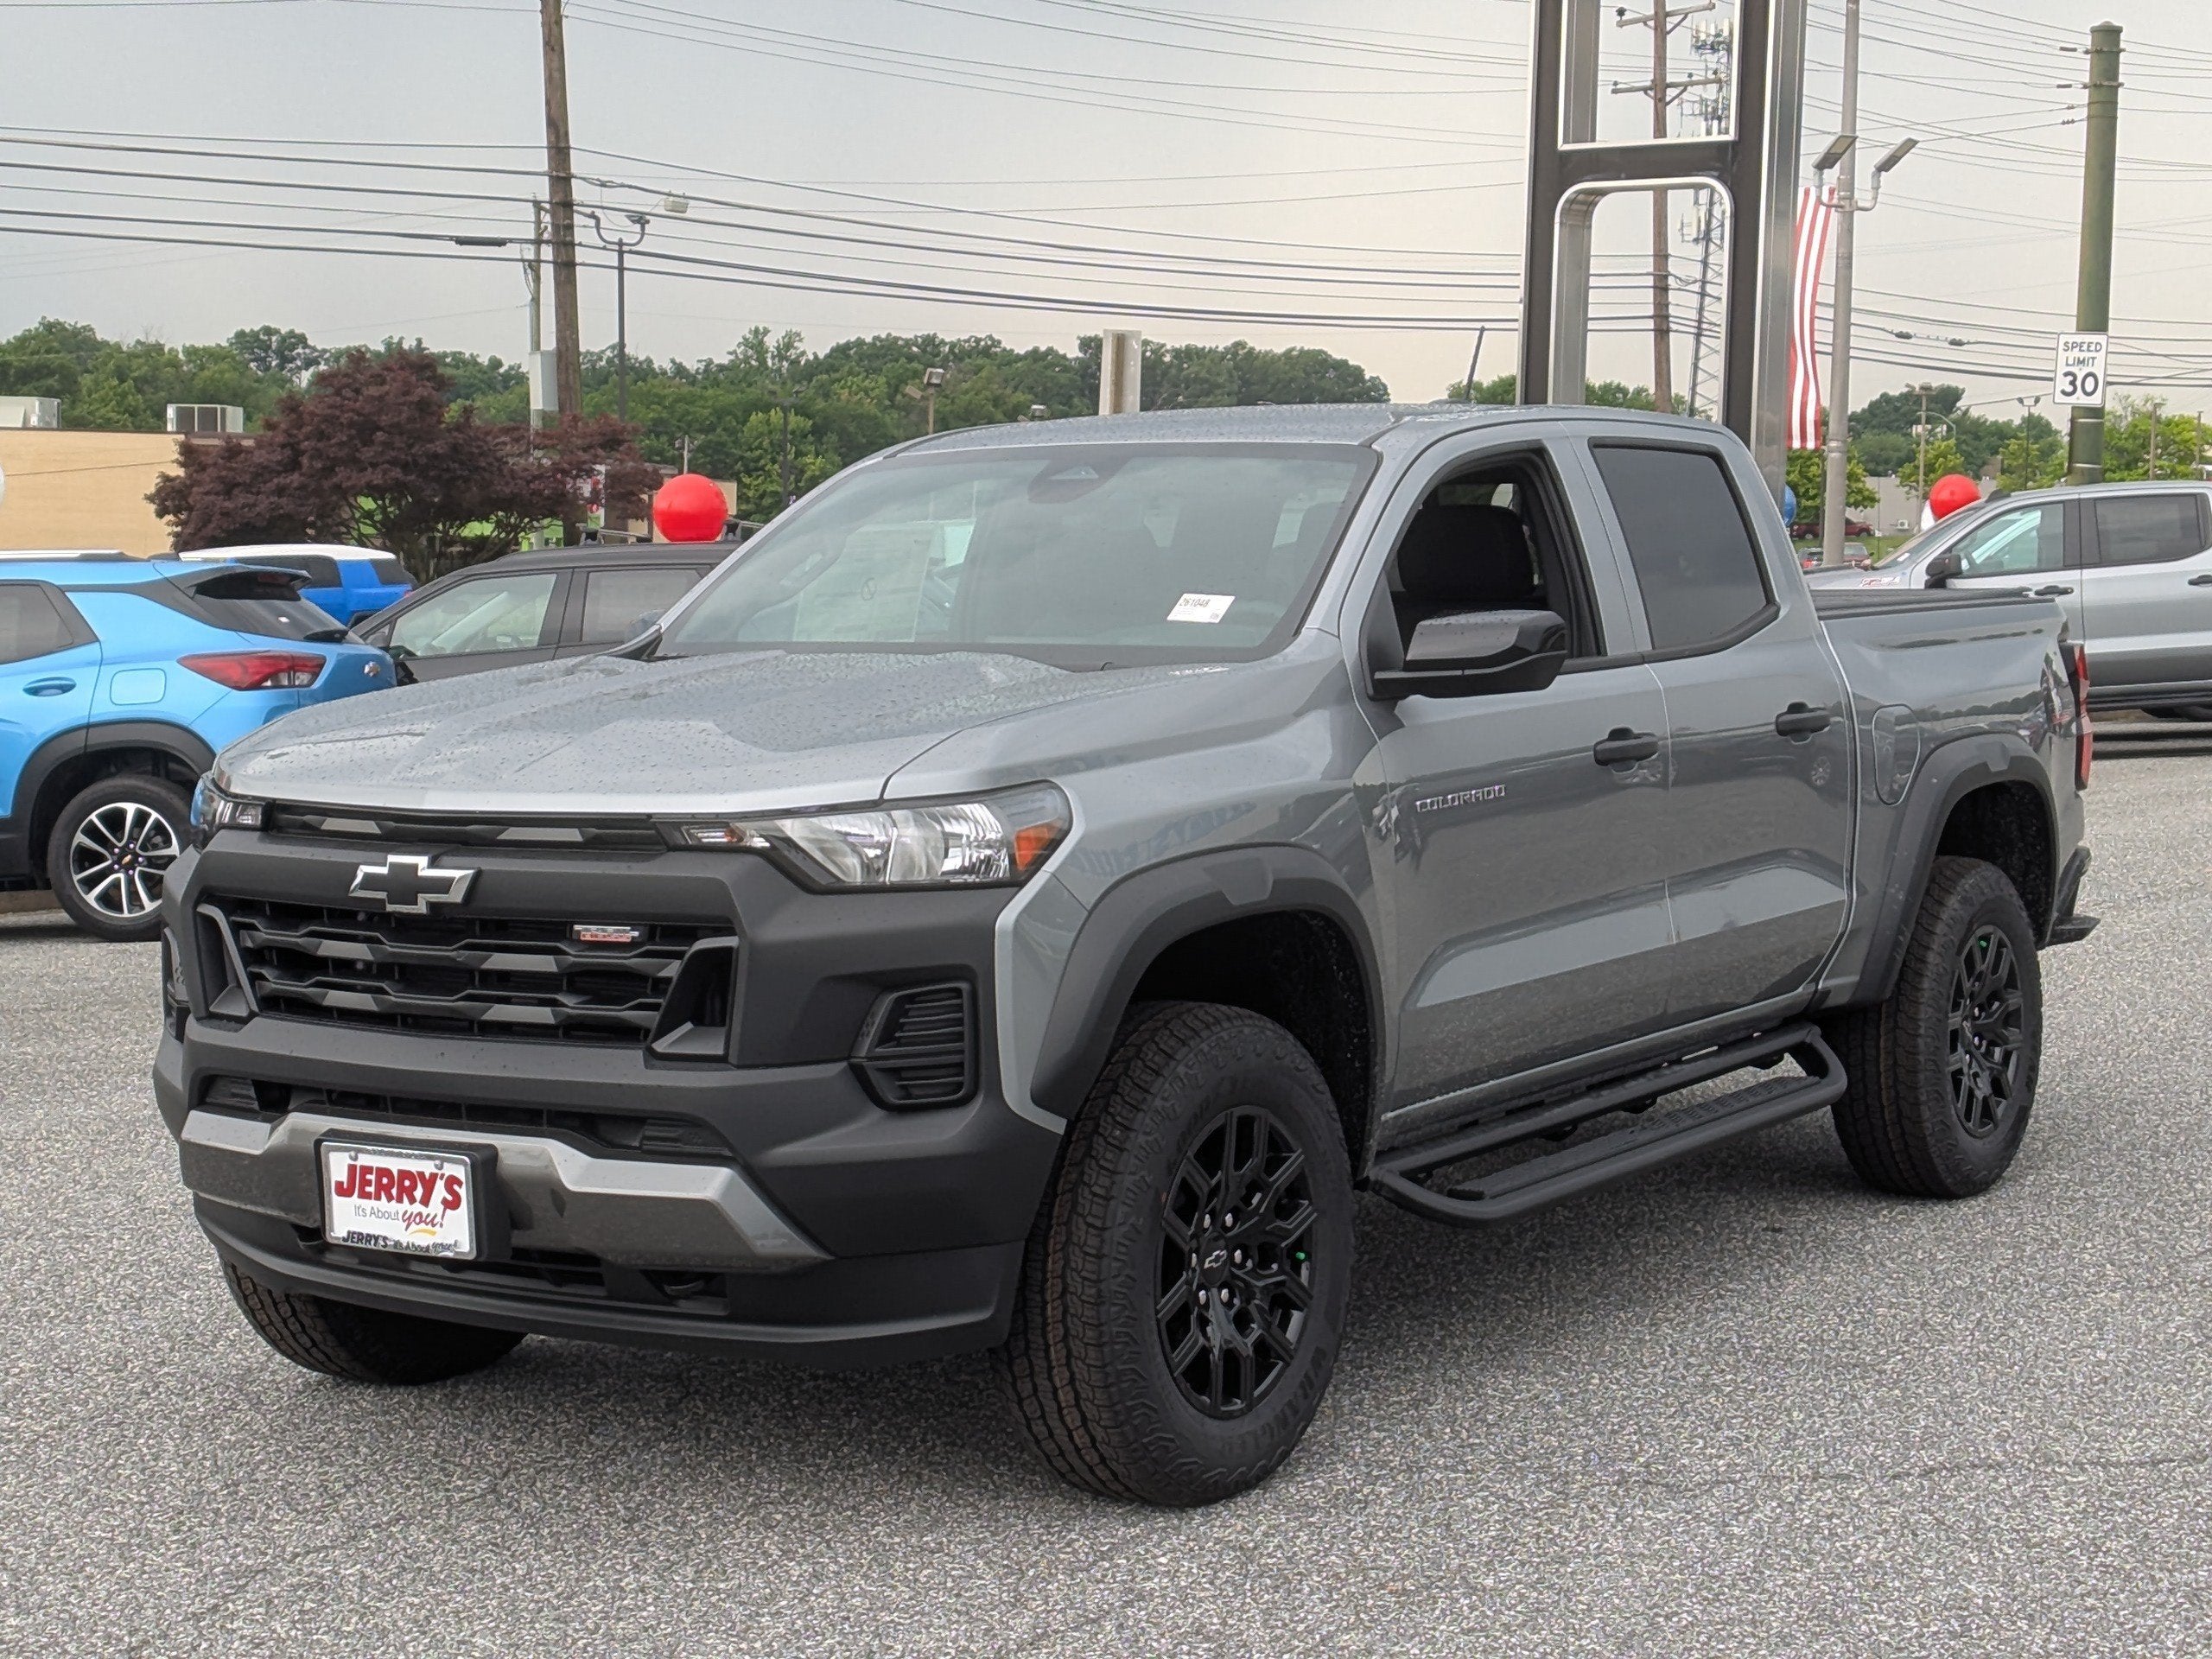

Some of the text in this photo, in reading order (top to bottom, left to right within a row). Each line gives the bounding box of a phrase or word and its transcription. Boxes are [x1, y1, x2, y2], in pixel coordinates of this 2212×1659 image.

[2062, 340, 2103, 353] SPEED
[2065, 355, 2098, 367] LIMIT
[2060, 370, 2100, 397] 30
[1415, 784, 1506, 813] COLORADO
[334, 1163, 464, 1211] JERRY'S
[353, 1204, 448, 1232] It's About you!
[341, 1229, 390, 1249] JERRY'S
